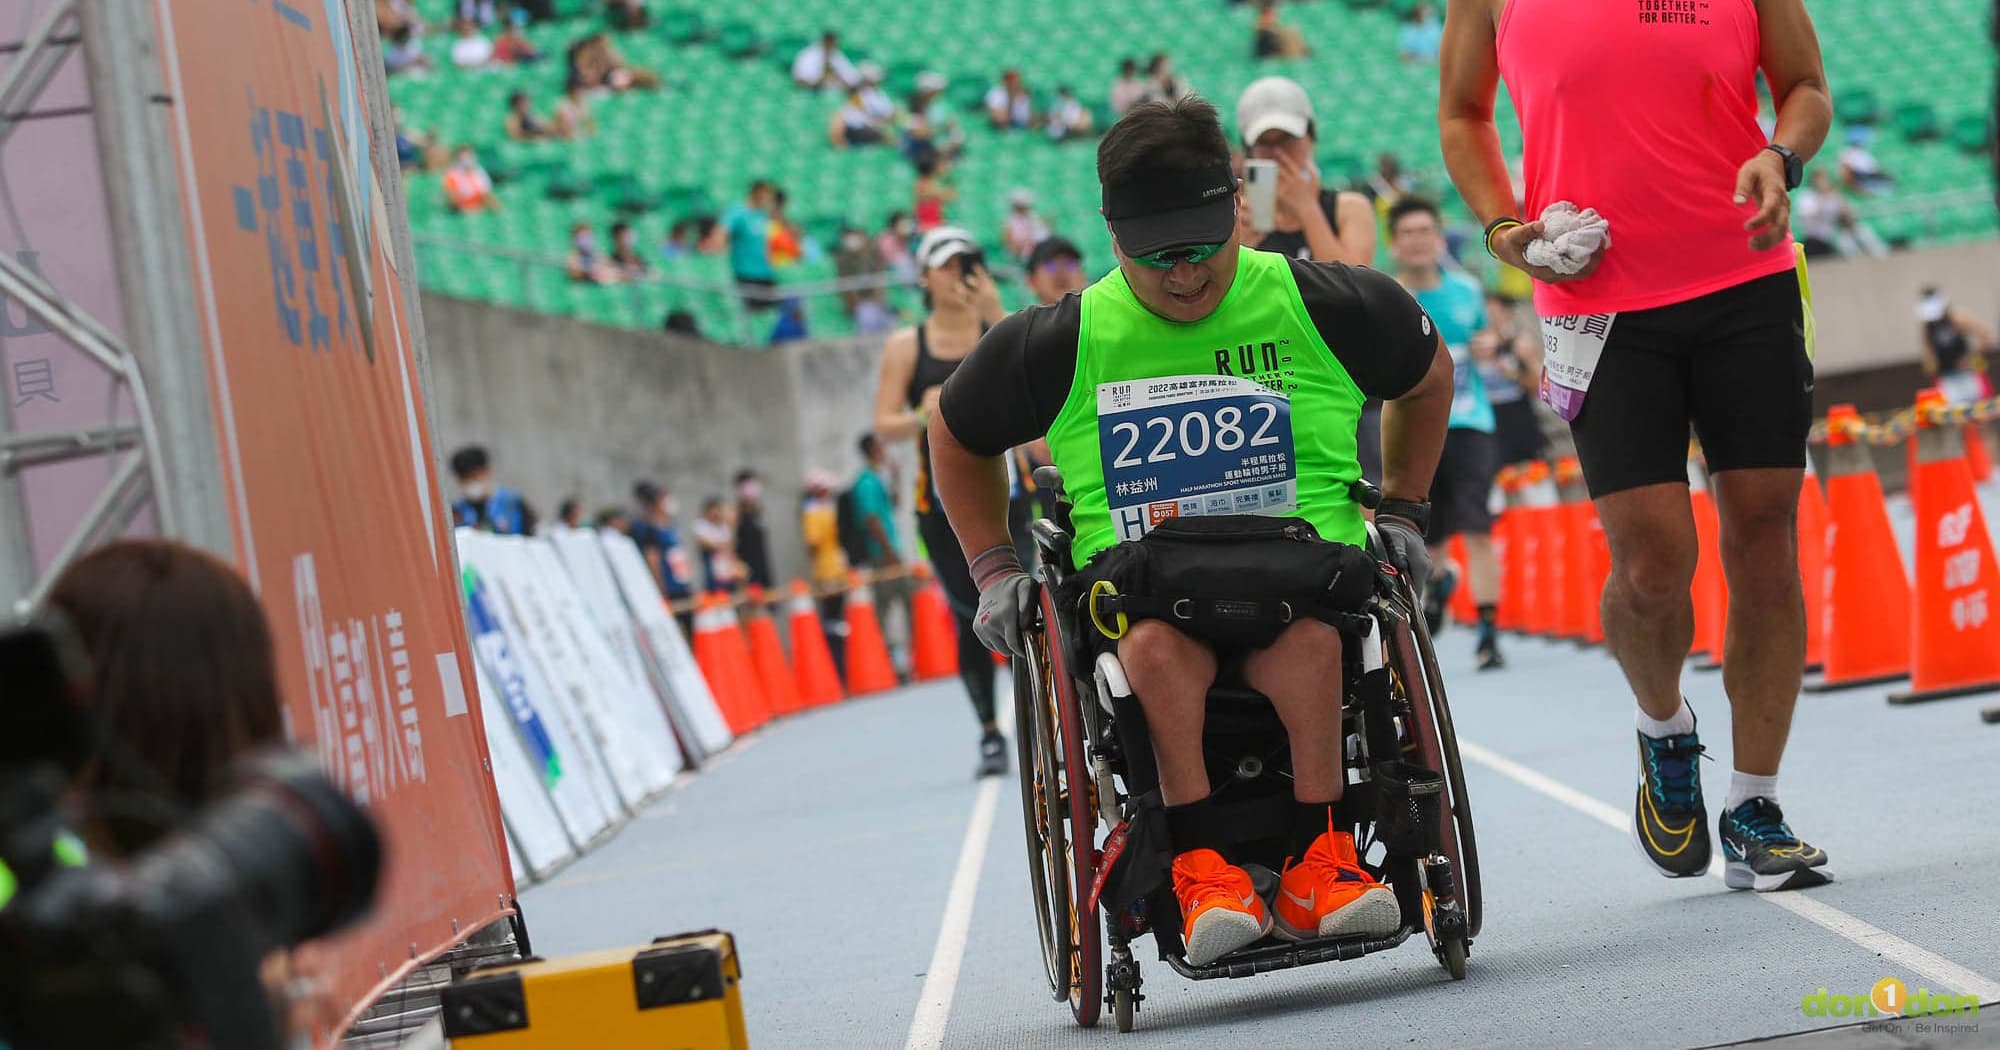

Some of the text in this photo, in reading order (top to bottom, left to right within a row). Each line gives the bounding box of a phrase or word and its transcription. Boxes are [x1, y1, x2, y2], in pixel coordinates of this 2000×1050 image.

[1638, 0, 1696, 12] TOGETHER
[1639, 12, 1697, 25] FOR BETTER
[1215, 342, 1279, 377] RUN
[1112, 384, 1131, 395] RUN
[1112, 402, 1280, 469] 22082
[1241, 453, 1286, 467] 半程馬拉松
[1224, 463, 1287, 480] 運動輪椅男子組
[1115, 476, 1158, 497] 林益州
[1193, 482, 1223, 492] MARATHON
[1223, 479, 1240, 488] SPORT
[1240, 474, 1273, 484] WHEELCHAIR
[1160, 509, 1174, 518] 057
[1121, 507, 1146, 539] H
